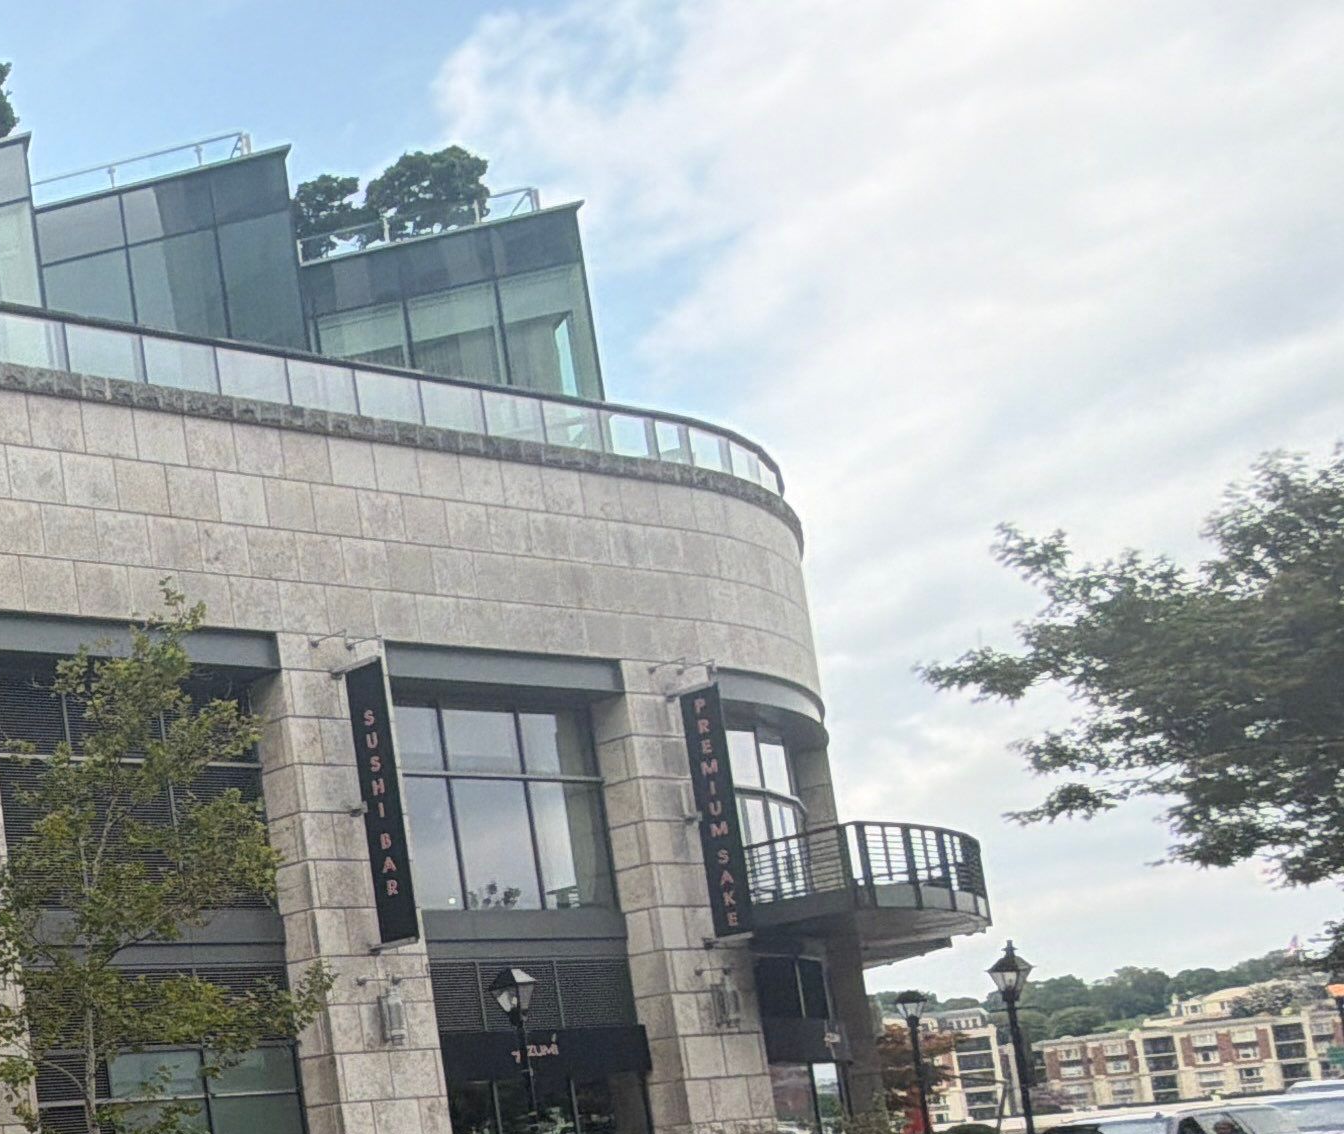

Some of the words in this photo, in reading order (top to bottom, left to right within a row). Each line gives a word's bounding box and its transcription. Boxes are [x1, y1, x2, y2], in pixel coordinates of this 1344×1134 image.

[363, 709, 385, 818] SUSHI
[379, 832, 399, 896] BAR
[693, 698, 728, 838] PREMIUM
[717, 849, 739, 927] SAKE
